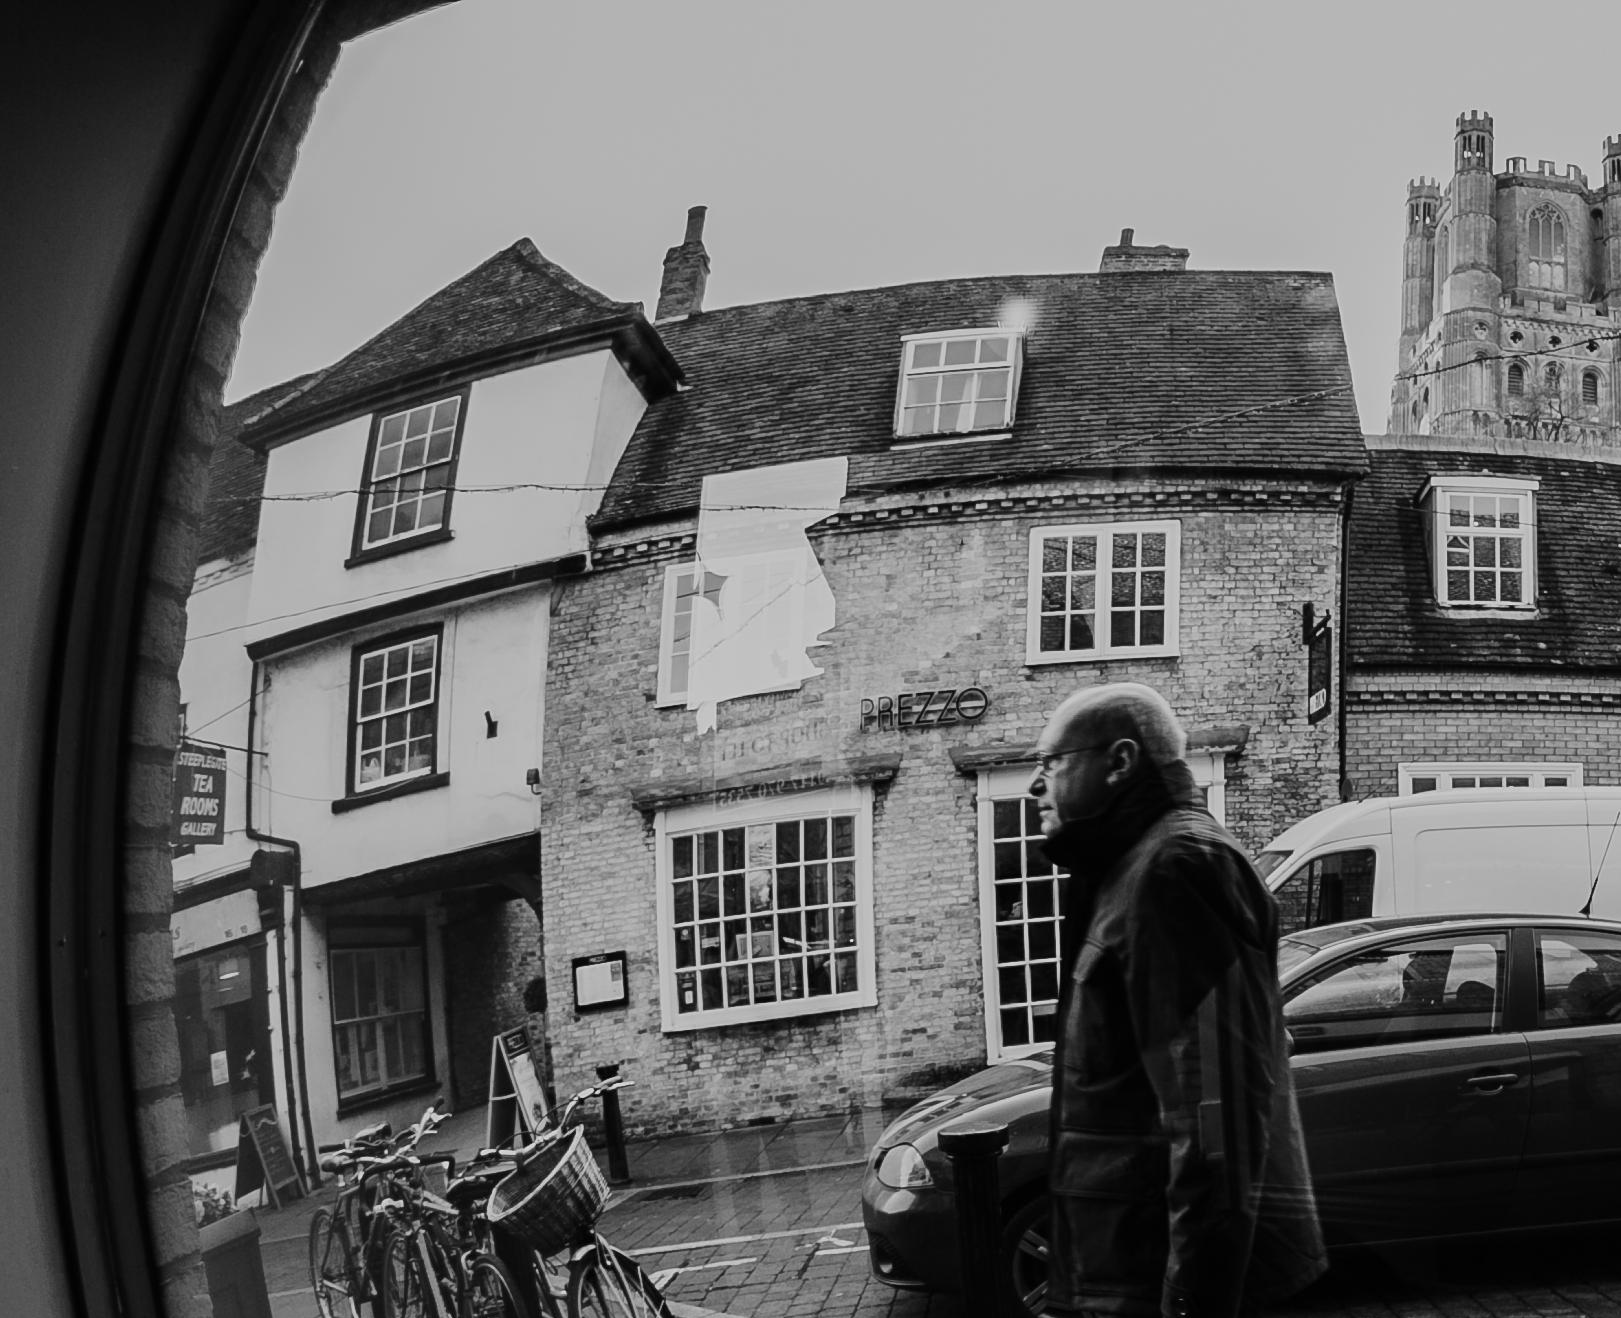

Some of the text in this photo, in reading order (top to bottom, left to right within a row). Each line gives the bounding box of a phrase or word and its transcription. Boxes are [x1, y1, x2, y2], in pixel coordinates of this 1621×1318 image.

[860, 687, 988, 731] PREZZO
[193, 773, 213, 793] TEA
[180, 796, 219, 816] ROOMS
[180, 821, 217, 836] GALLERY
